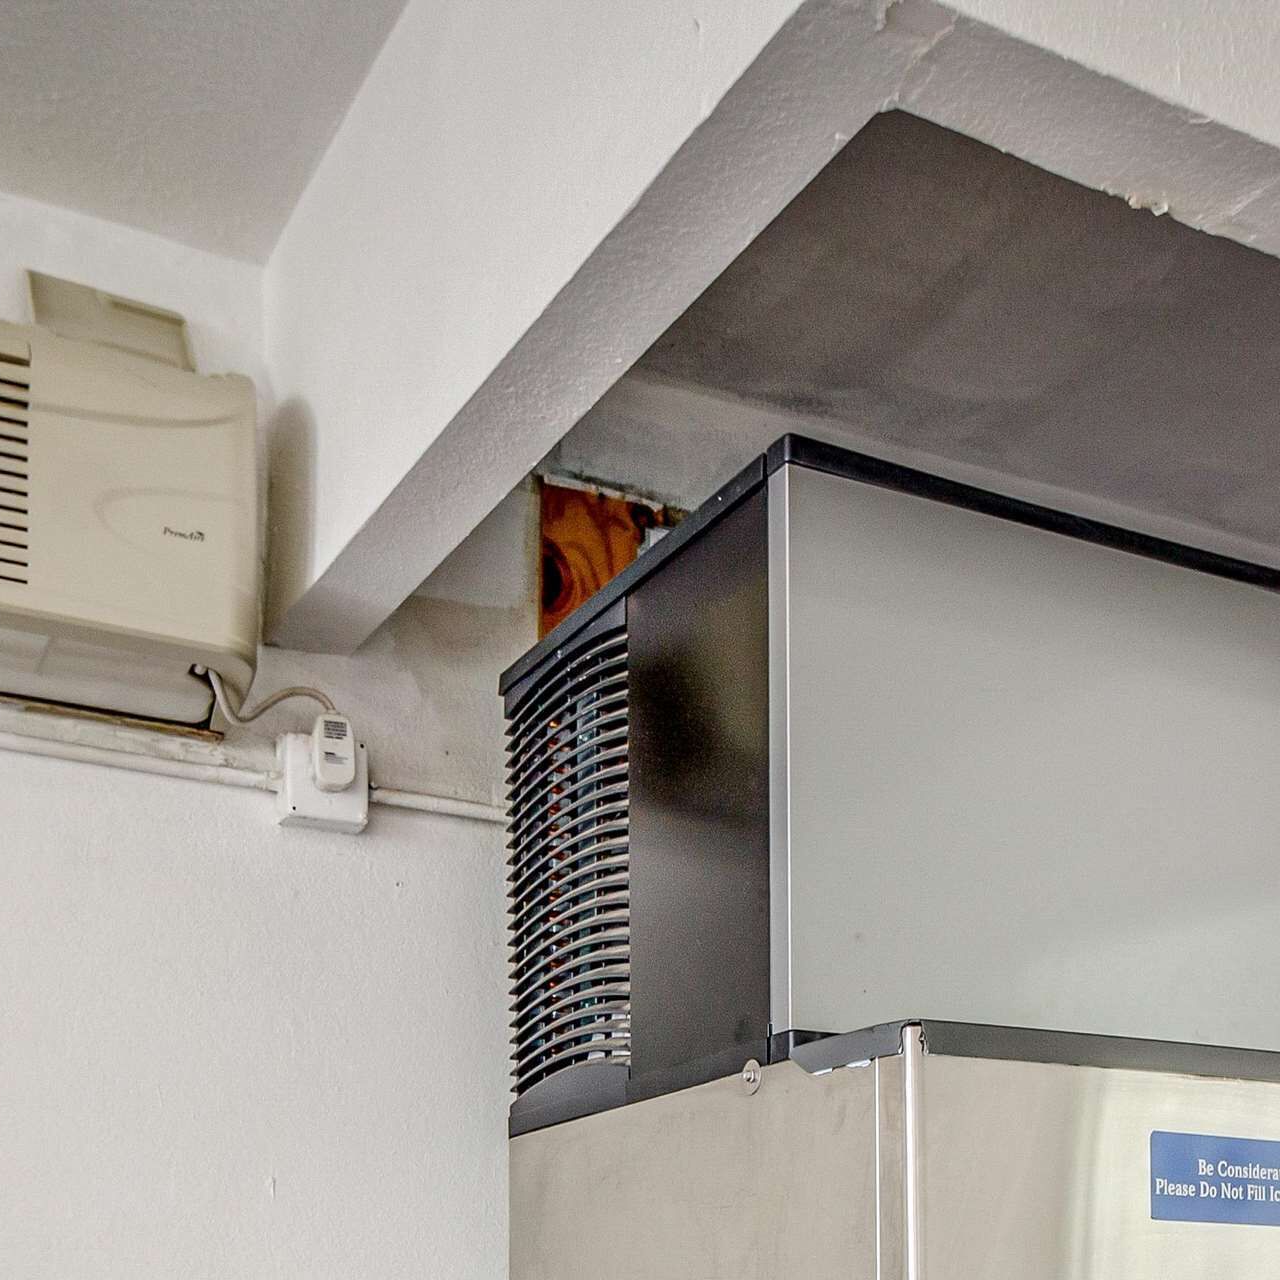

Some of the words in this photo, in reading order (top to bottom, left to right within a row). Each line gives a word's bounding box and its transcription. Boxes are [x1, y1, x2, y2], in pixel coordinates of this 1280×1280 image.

[1198, 1159, 1214, 1176] Be
[1155, 1178, 1196, 1197] Please
[1199, 1182, 1217, 1198] Do
[1221, 1183, 1244, 1200] Not
[1247, 1184, 1266, 1201] Fill
